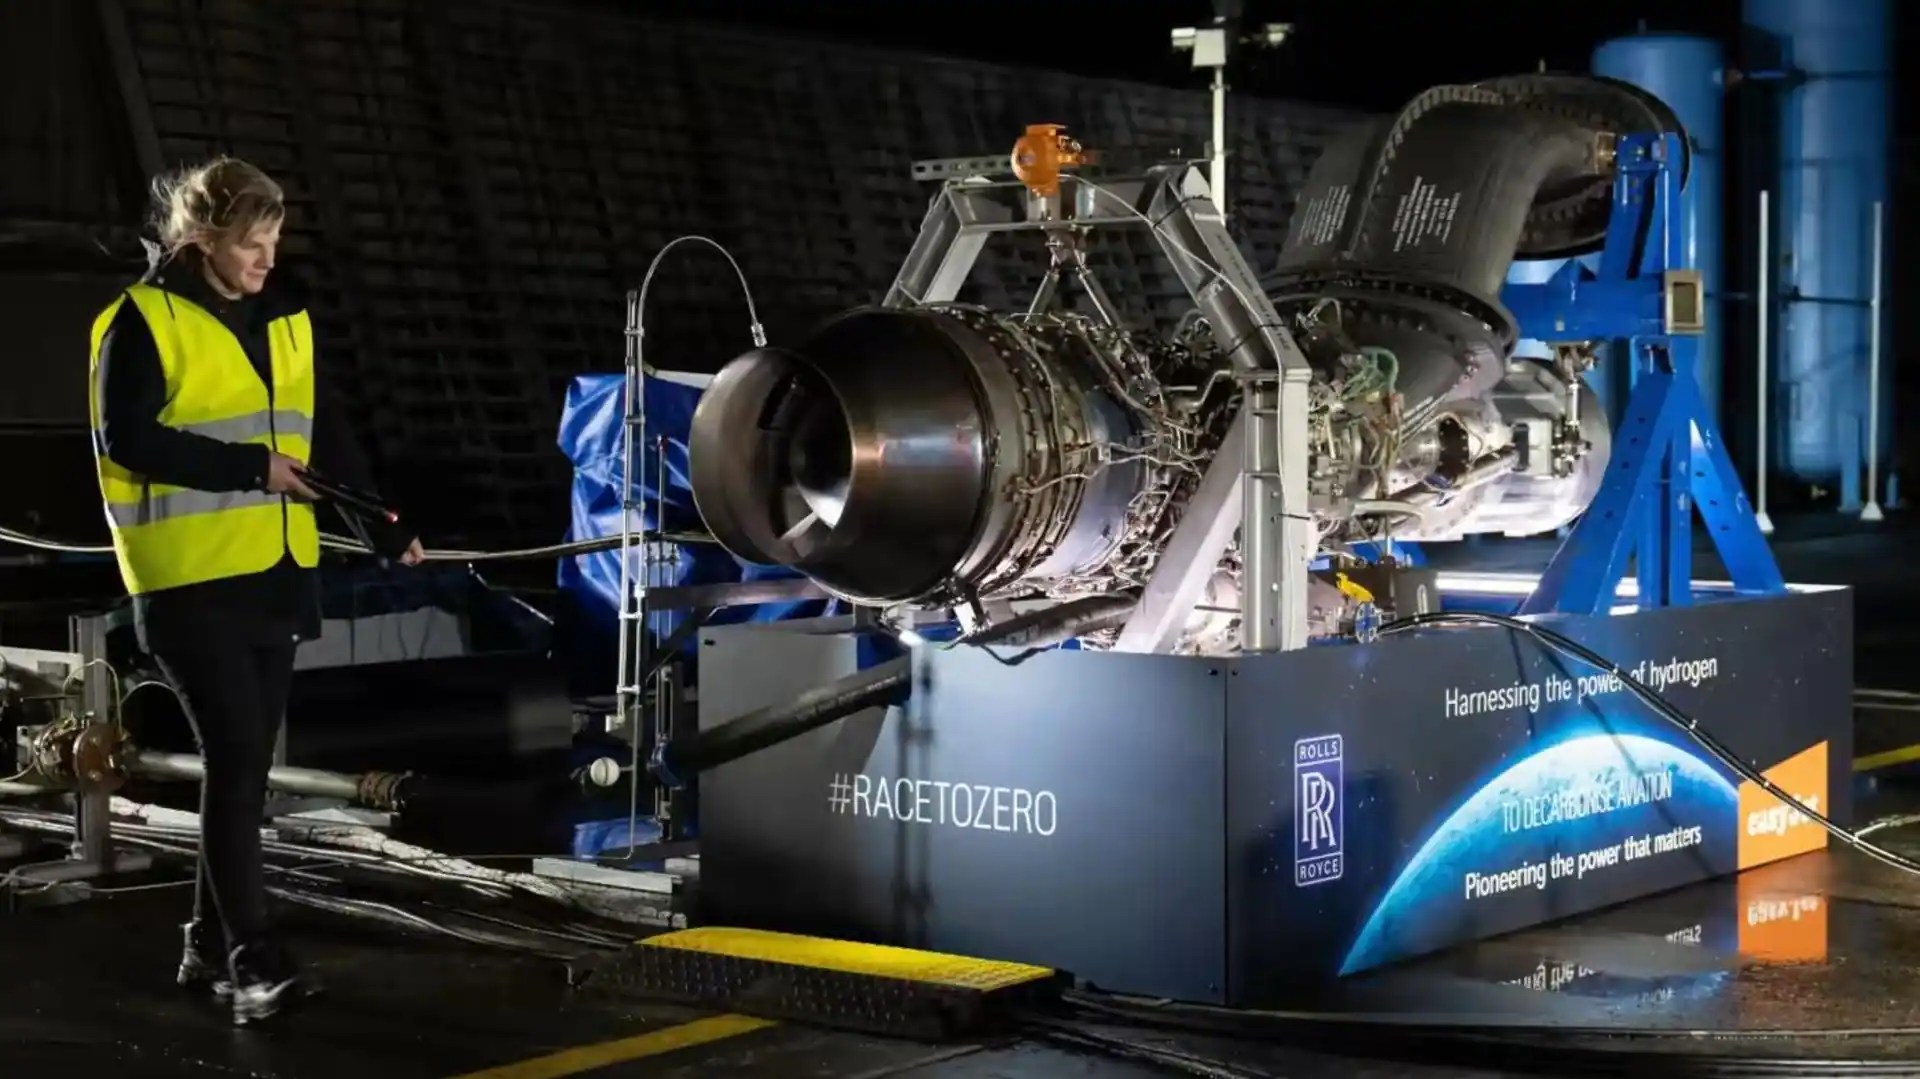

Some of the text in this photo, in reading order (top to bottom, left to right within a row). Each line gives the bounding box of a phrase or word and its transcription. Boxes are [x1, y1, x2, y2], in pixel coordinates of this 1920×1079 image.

[1445, 680, 1540, 718] Harnessing
[1546, 673, 1572, 702] the
[1650, 656, 1718, 692] hydrogen
[1300, 741, 1338, 760] ROLLS
[828, 772, 1057, 836] #RACETOZERO
[1502, 770, 1673, 833] TO DECARBONISE AVIATION
[1300, 858, 1339, 879] ROYCE
[1465, 826, 1702, 899] Pioneering the power that matters
